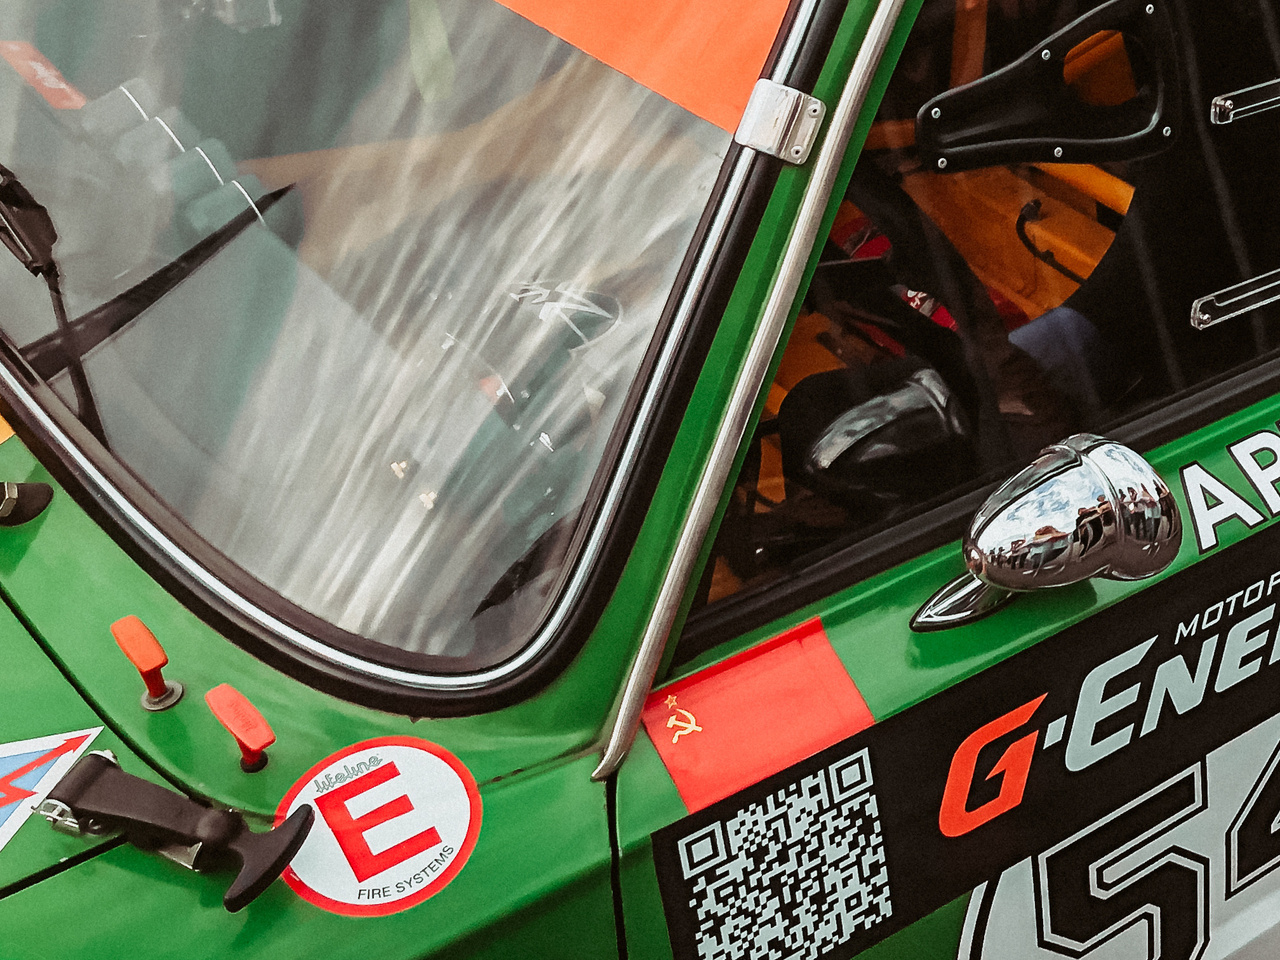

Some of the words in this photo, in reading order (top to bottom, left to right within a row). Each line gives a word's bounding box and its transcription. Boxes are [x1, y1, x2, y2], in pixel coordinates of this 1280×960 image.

[313, 760, 443, 884] E
[357, 885, 392, 901] FIRE
[395, 844, 455, 894] SYSTEMS
